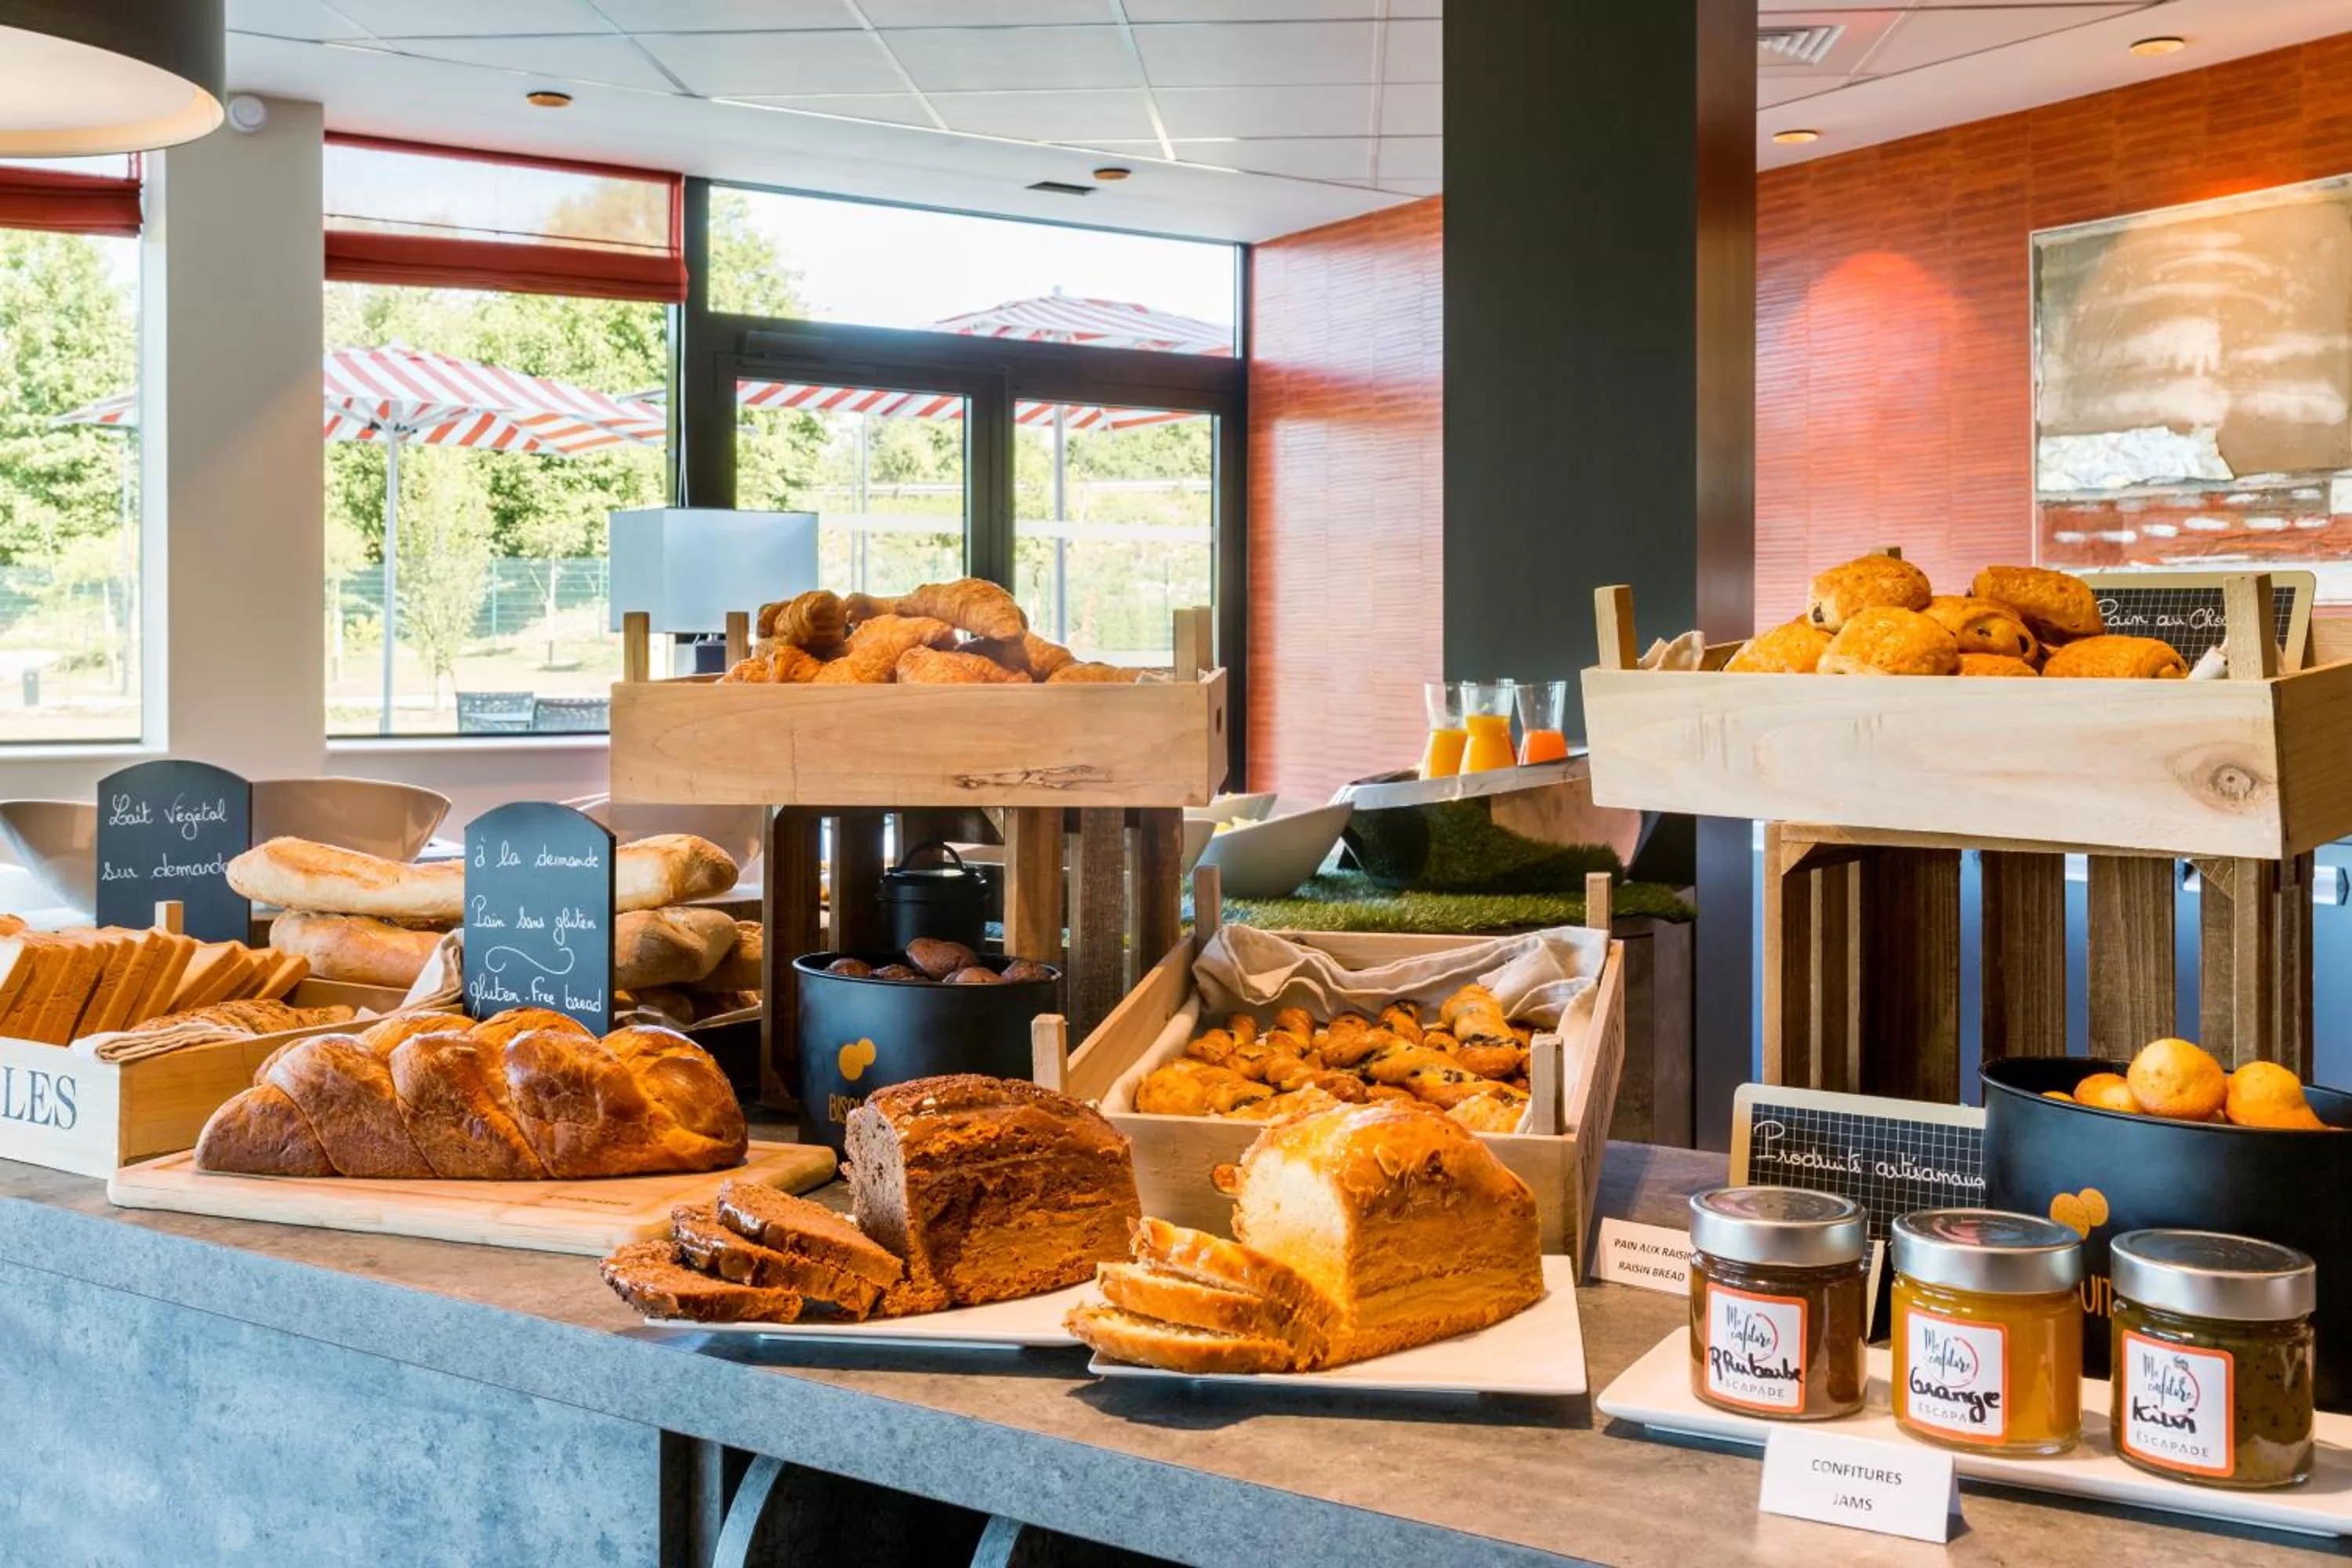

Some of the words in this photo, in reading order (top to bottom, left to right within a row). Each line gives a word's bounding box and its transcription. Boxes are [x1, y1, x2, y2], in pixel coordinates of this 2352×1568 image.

[2096, 598, 2149, 626] Pain
[2156, 615, 2185, 626] au
[109, 793, 154, 826] Lait
[495, 840, 521, 868] la
[534, 844, 600, 868] demande
[471, 895, 506, 928] Pain
[553, 907, 597, 946] gluten
[564, 984, 602, 1012] bread
[1, 1066, 78, 1131] LES
[1613, 1239, 1638, 1250] PAIN
[1639, 1243, 1661, 1254] AUX
[1618, 1261, 1651, 1274] RAISIN
[1652, 1268, 1686, 1282] BREAD
[2136, 1430, 2209, 1458] ESCAPADE
[1811, 1458, 1903, 1486] CONFITURES
[1832, 1492, 1873, 1512] JAMS
